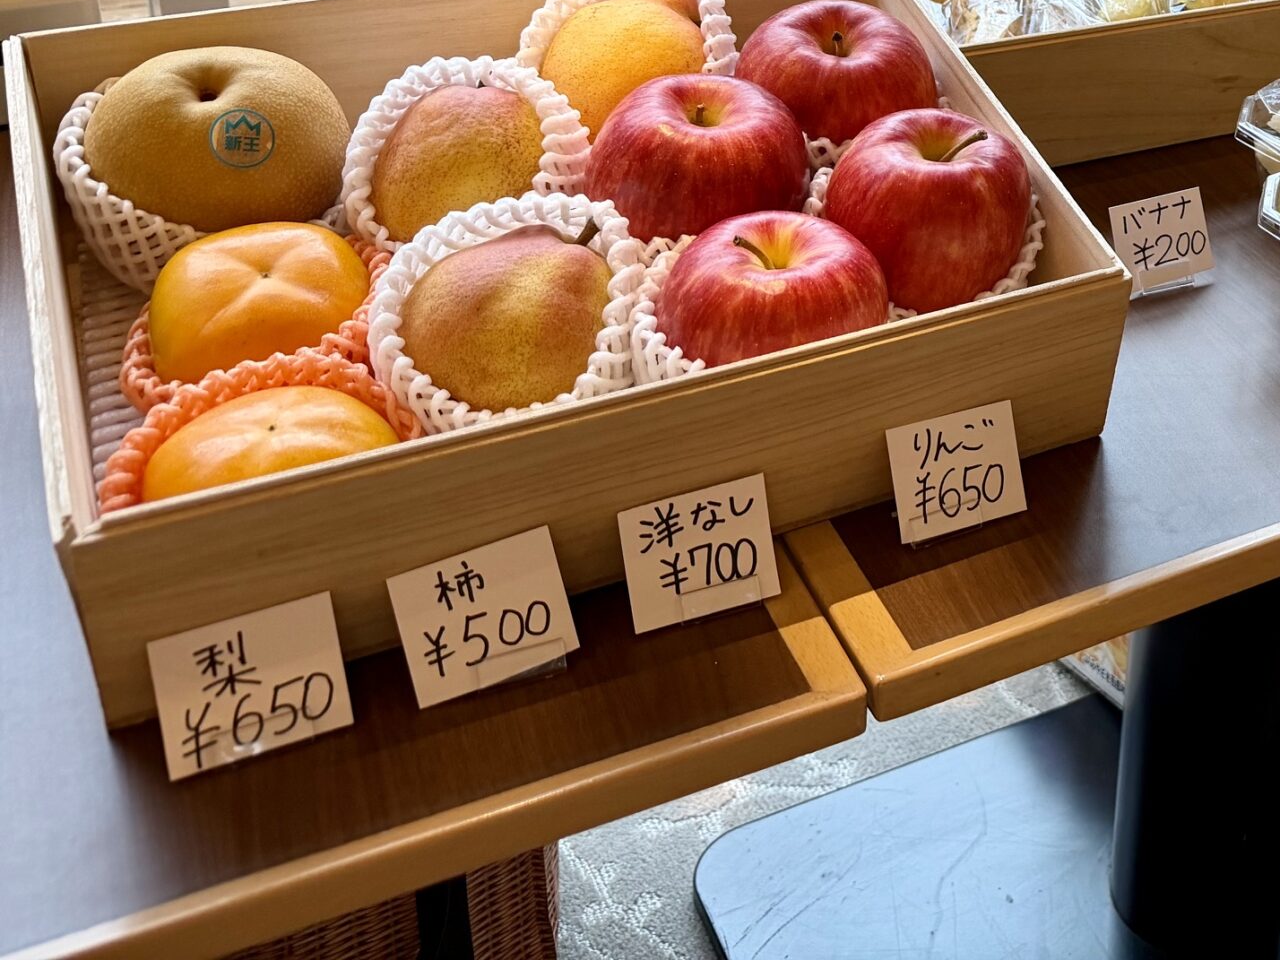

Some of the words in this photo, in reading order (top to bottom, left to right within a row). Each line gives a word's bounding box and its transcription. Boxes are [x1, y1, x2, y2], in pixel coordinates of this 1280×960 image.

[225, 135, 261, 152] 新王
[1121, 197, 1193, 233] バナナ
[1132, 229, 1208, 272] ¥200
[912, 419, 995, 470] りんご
[913, 462, 1006, 526] ¥650
[637, 494, 755, 555] 洋なし
[434, 560, 487, 611] 柿
[658, 537, 759, 596] ¥700
[193, 631, 263, 700] 梨
[422, 599, 552, 678] ¥500
[181, 671, 335, 771] ¥650
